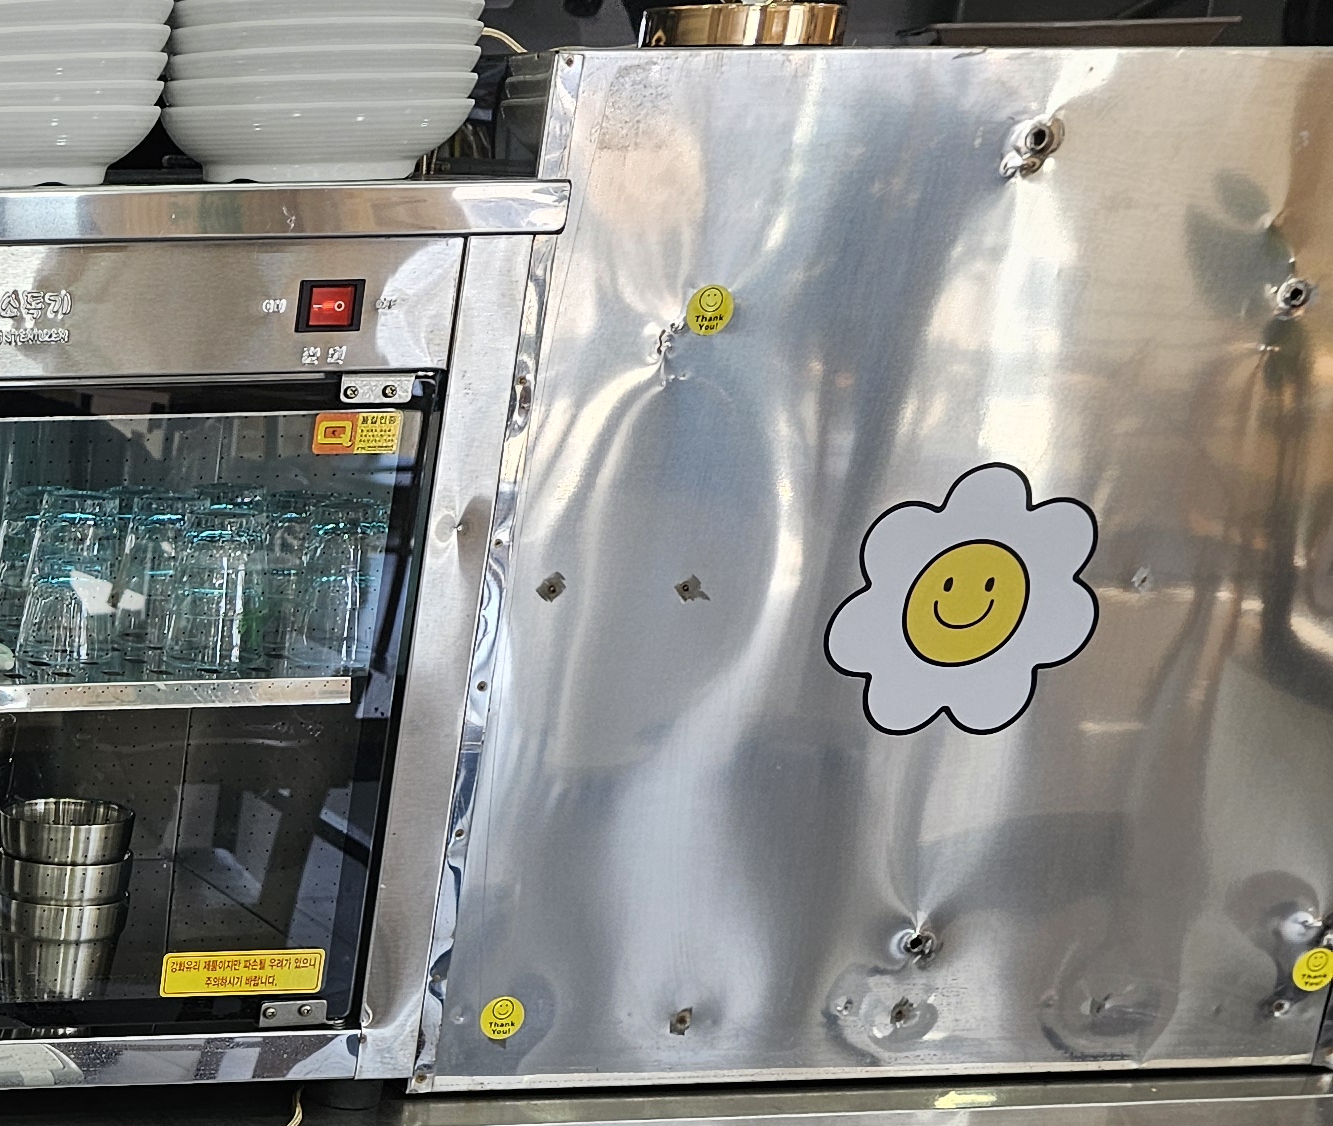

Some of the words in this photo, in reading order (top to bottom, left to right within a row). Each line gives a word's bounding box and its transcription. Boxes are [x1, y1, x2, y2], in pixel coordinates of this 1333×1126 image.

[695, 314, 724, 322] Thank
[699, 323, 718, 331] You!
[269, 957, 291, 970] 우려가
[294, 957, 317, 970] 있으니
[205, 976, 243, 988] 주의하시기
